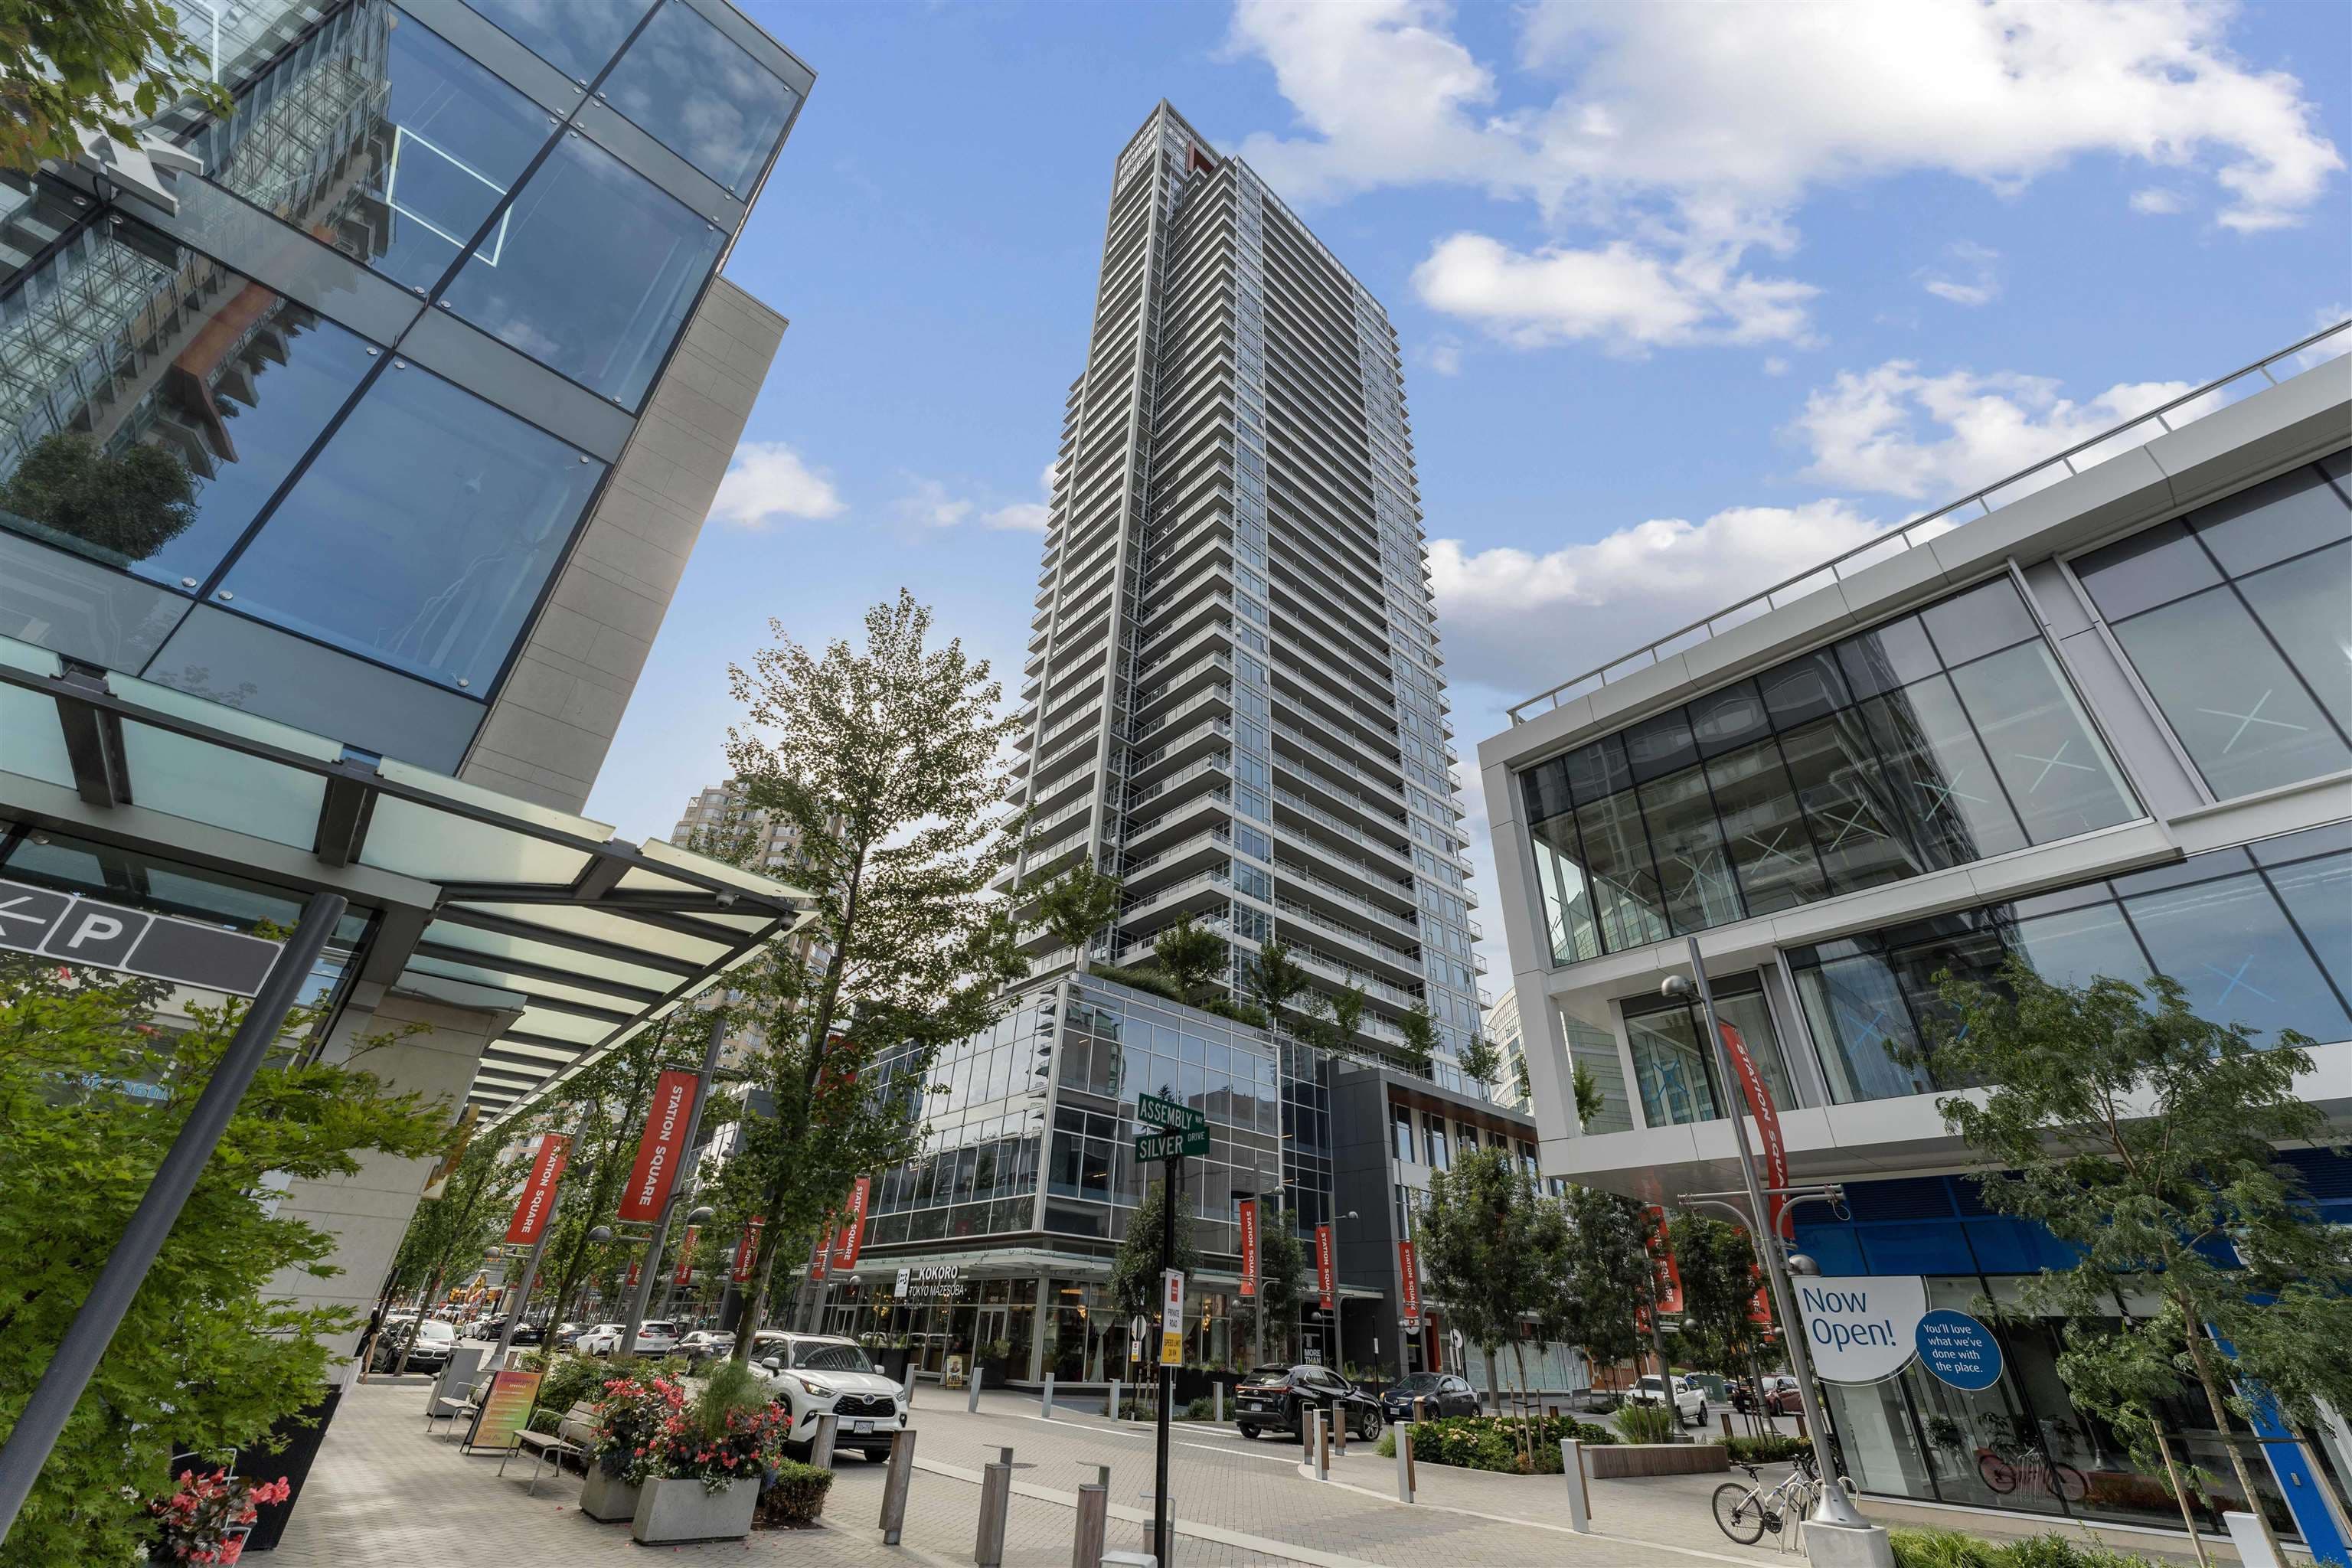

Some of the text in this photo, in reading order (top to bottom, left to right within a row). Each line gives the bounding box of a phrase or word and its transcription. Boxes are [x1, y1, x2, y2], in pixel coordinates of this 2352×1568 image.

[67, 913, 122, 948] P
[1736, 1044, 1771, 1122] STATION
[1140, 1099, 1192, 1129] ASSEMBLY
[639, 1085, 683, 1206] STATION SQUARE
[1139, 1132, 1205, 1158] SILVER DRIVE
[521, 1145, 560, 1233] STATION SQUARE
[844, 1185, 864, 1260] STATIO SQUARE
[1321, 1233, 1329, 1265] STATION
[919, 1266, 959, 1280] KOKORO
[1405, 1249, 1413, 1279] STATION
[909, 1285, 929, 1297] TOKYO
[929, 1284, 964, 1296] MAZESOBA
[1802, 1288, 1866, 1312] Now
[1812, 1318, 1896, 1352] Open!
[1923, 1324, 1971, 1334] You'll love
[1928, 1337, 1983, 1348] what we've
[1305, 1357, 1321, 1366] THAN
[1932, 1349, 1981, 1360] done with
[1936, 1361, 1983, 1374] the place.
